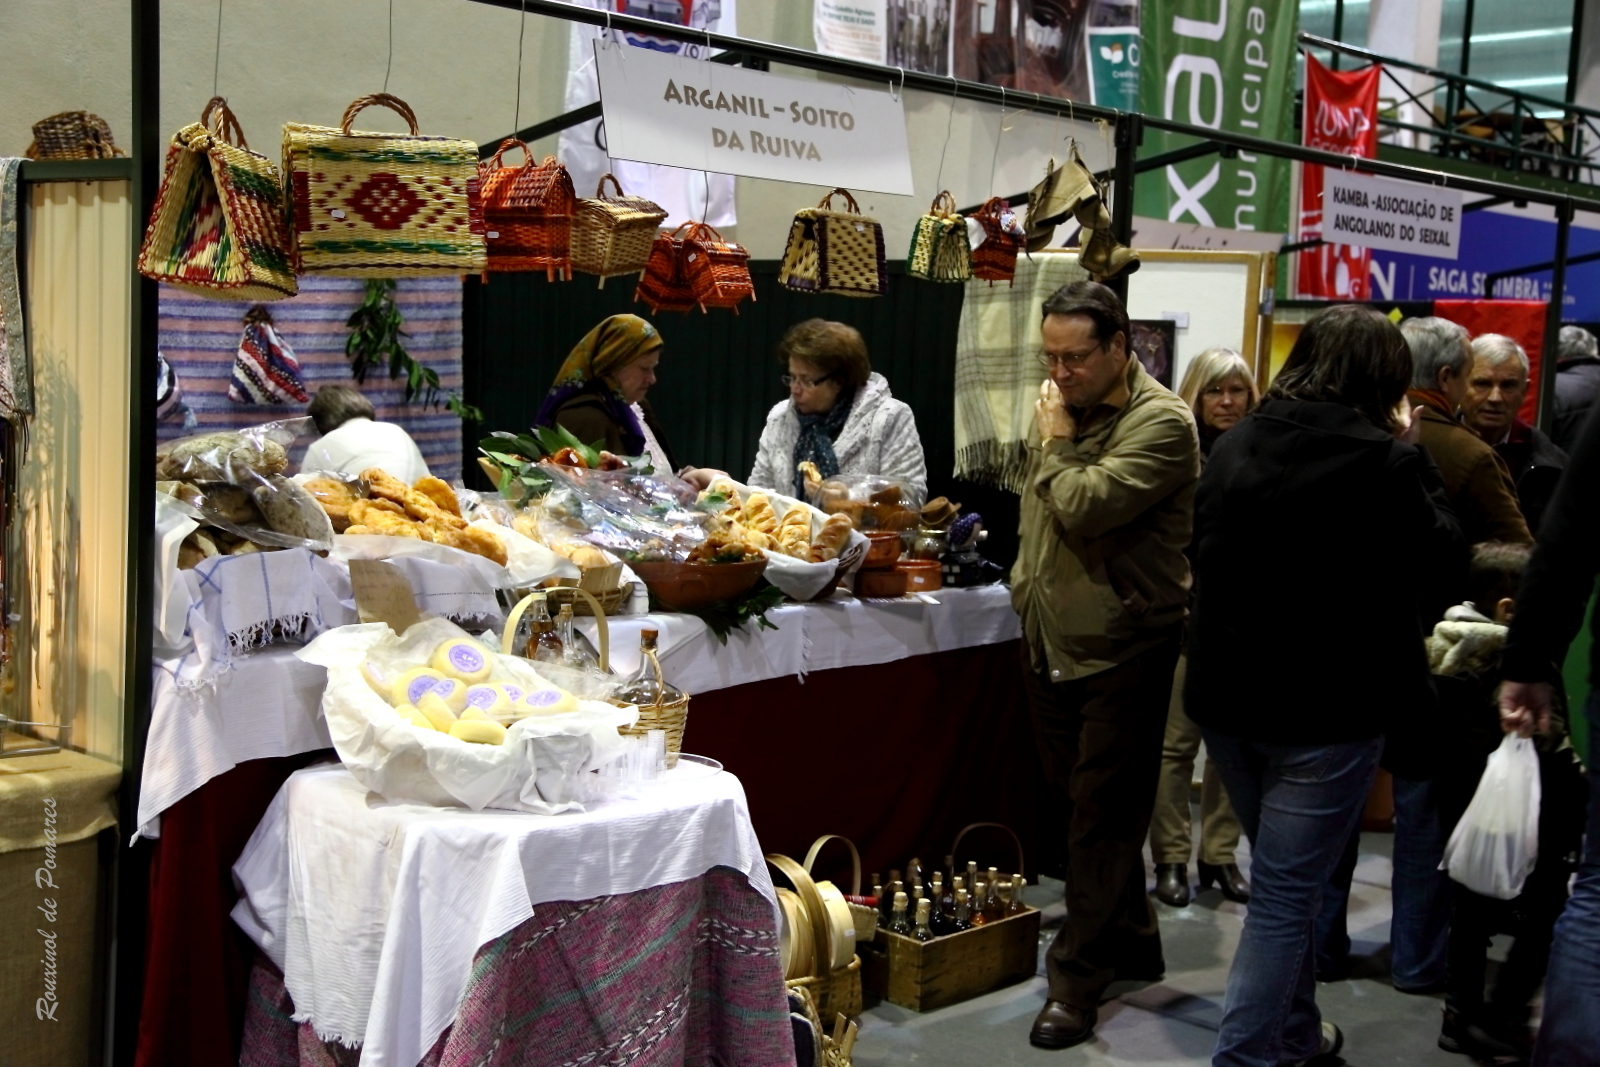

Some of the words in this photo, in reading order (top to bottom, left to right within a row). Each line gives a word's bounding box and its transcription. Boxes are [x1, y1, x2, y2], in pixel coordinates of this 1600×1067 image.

[711, 127, 745, 152] DA
[750, 130, 822, 162] RUIVA
[1440, 206, 1454, 222] DE
[1333, 213, 1396, 239] ANGOLANOS
[1400, 224, 1415, 242] DO
[1419, 228, 1451, 247] SEIXAL
[1428, 266, 1468, 294] SAGA
